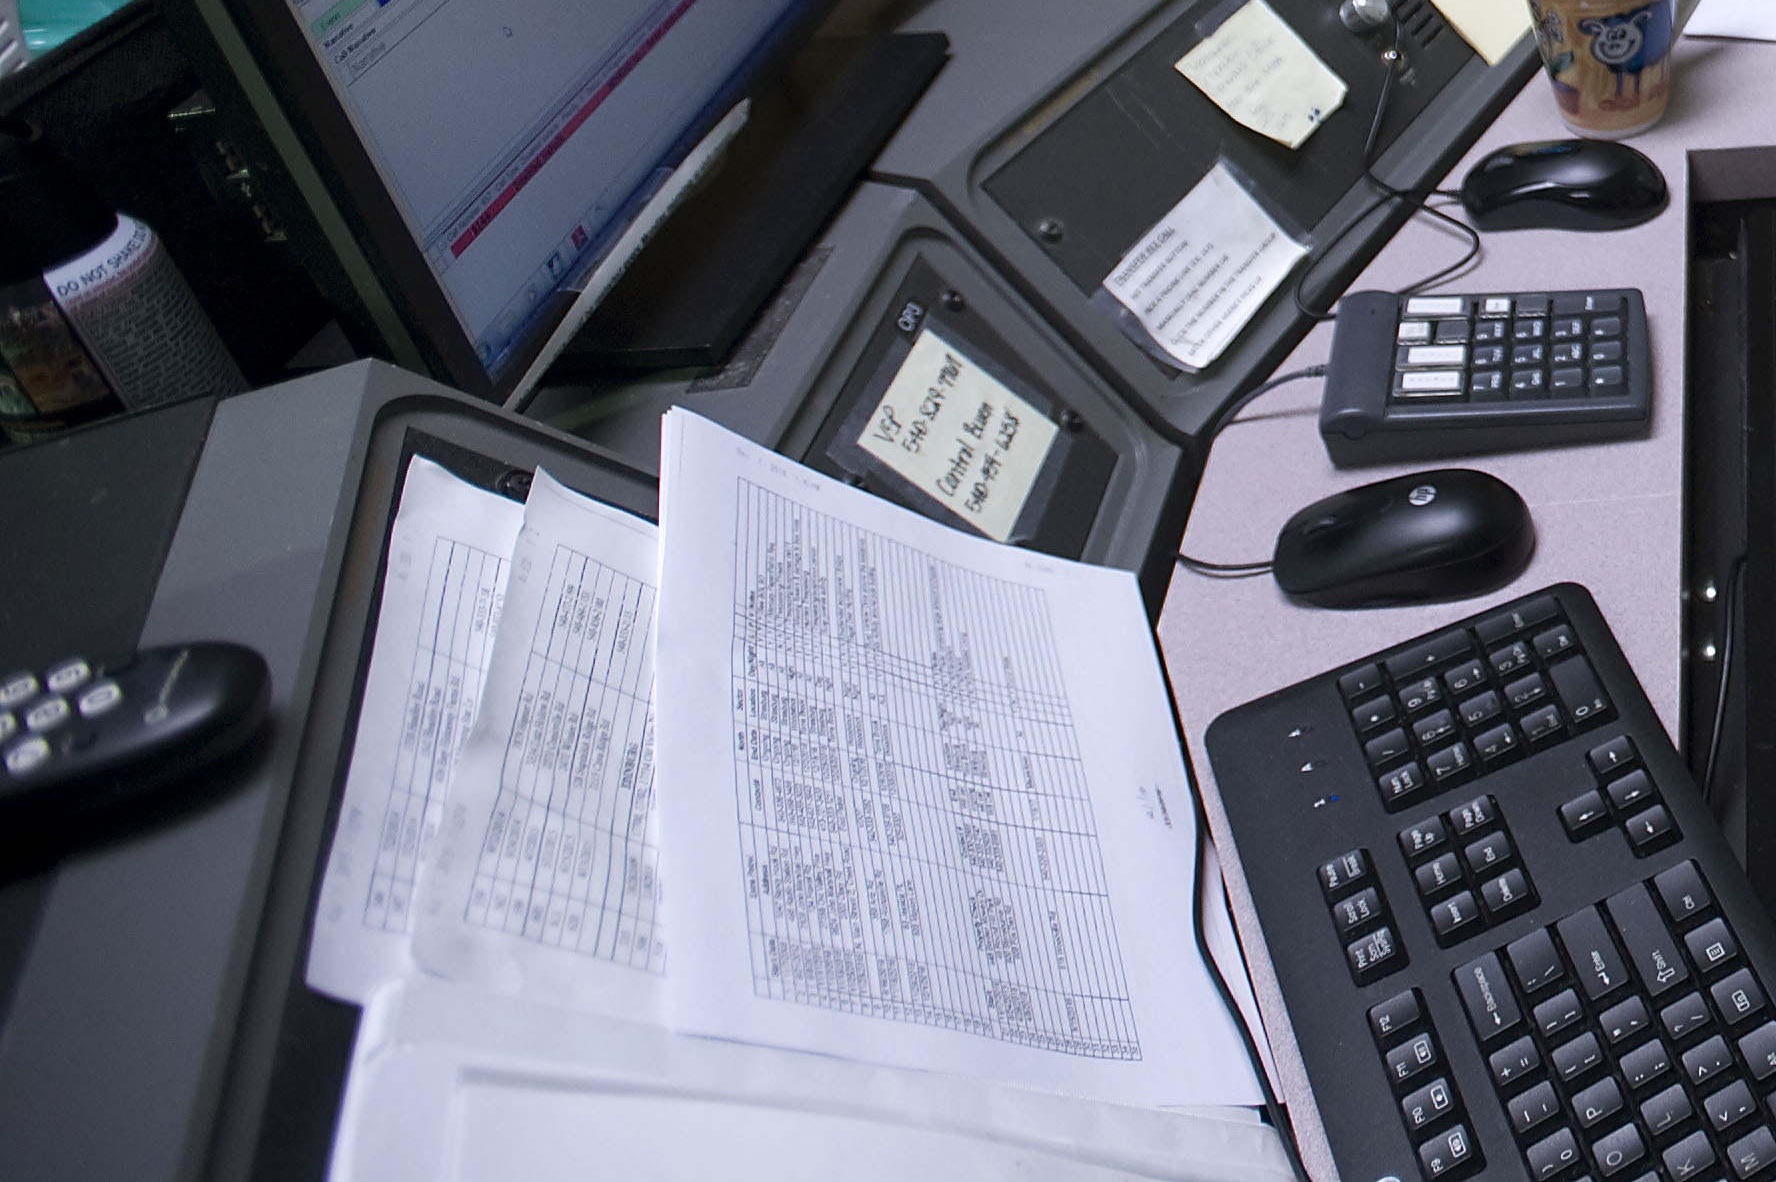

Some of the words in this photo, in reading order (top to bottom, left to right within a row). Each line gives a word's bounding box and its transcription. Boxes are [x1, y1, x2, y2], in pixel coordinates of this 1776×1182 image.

[322, 24, 354, 49] Narrative
[334, 49, 349, 65] Call
[347, 27, 378, 52] Narrative
[56, 280, 79, 296] DO
[81, 264, 108, 285] NOT
[107, 240, 141, 268] SHAKE
[1140, 263, 1166, 289] TRANSFER
[1165, 241, 1188, 263] BUTTON
[1196, 293, 1220, 317] NUMBER
[1234, 252, 1258, 276] TRANSFER
[1157, 300, 1186, 329] MANUALLY
[873, 405, 902, 443] VSP
[936, 438, 975, 498] Control
[748, 687, 757, 716] Location
[1483, 846, 1496, 863] End
[1325, 863, 1339, 889] Pause
[1432, 861, 1444, 886] Home
[1498, 877, 1513, 902] Delete
[1342, 903, 1358, 925] Scroll
[1357, 898, 1370, 919] Lock
[1447, 901, 1462, 925] Insert
[1354, 947, 1367, 969] Print
[1590, 949, 1606, 973] Enter
[1651, 947, 1668, 971] Shift
[1473, 966, 1498, 1013] Backspace
[1379, 1013, 1393, 1033] F12
[1396, 1061, 1409, 1078] F11
[1411, 1106, 1426, 1125] F10
[1585, 1106, 1603, 1120] P
[1656, 1113, 1672, 1128] L
[1430, 1157, 1444, 1174] F9
[1606, 1150, 1623, 1166] O
[1677, 1158, 1695, 1176] K
[1740, 1152, 1760, 1172] M
